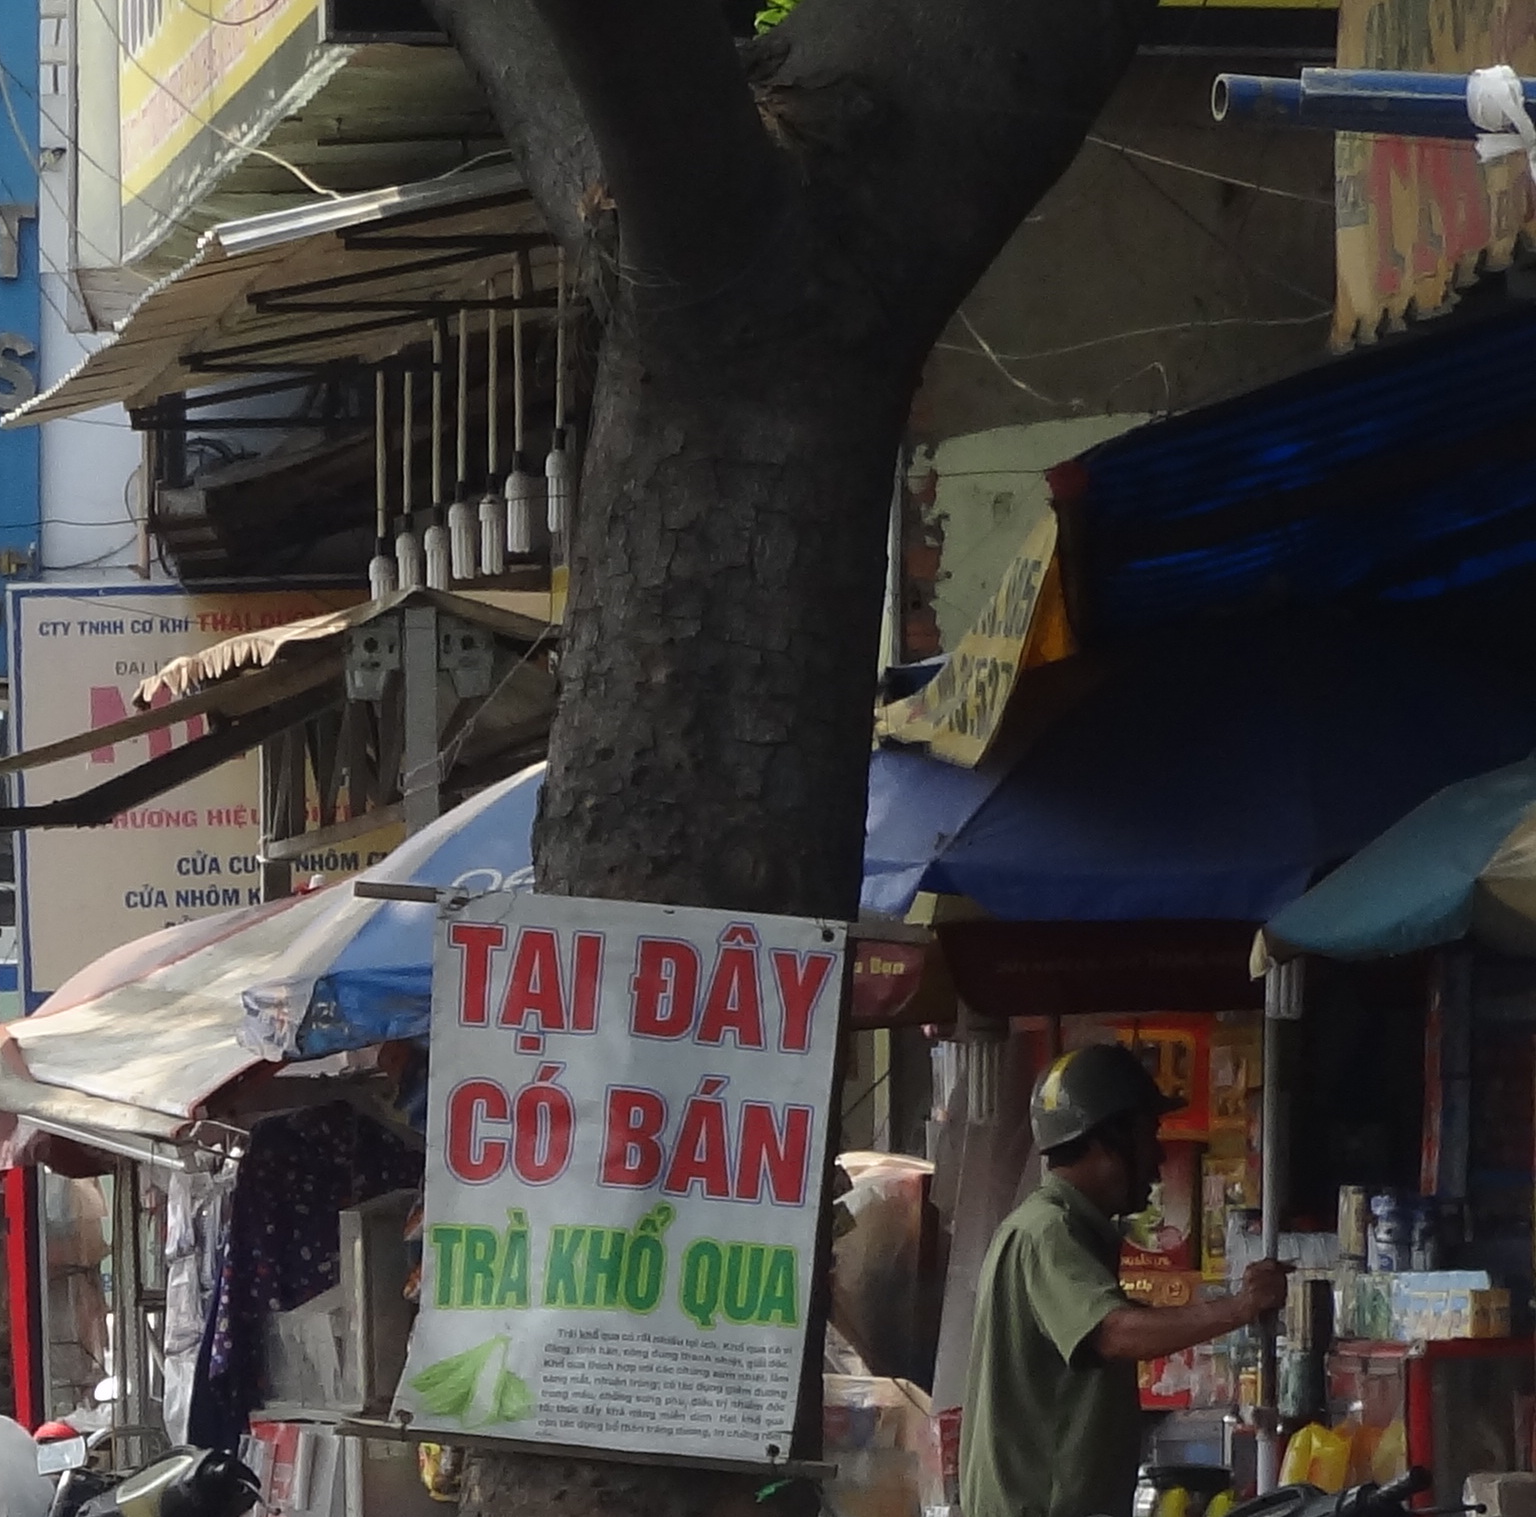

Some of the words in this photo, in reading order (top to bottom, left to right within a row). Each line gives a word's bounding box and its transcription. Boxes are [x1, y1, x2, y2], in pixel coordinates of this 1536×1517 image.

[39, 622, 71, 637] CTY
[78, 620, 124, 635] TNHH
[448, 922, 604, 1054] TẠI
[631, 923, 835, 1054] ĐÂY
[445, 1062, 574, 1185] CÓ
[600, 1075, 813, 1206] BÁN
[431, 1206, 532, 1309] TRÀ
[543, 1201, 677, 1315] KHỔ
[679, 1237, 802, 1331] QUA
